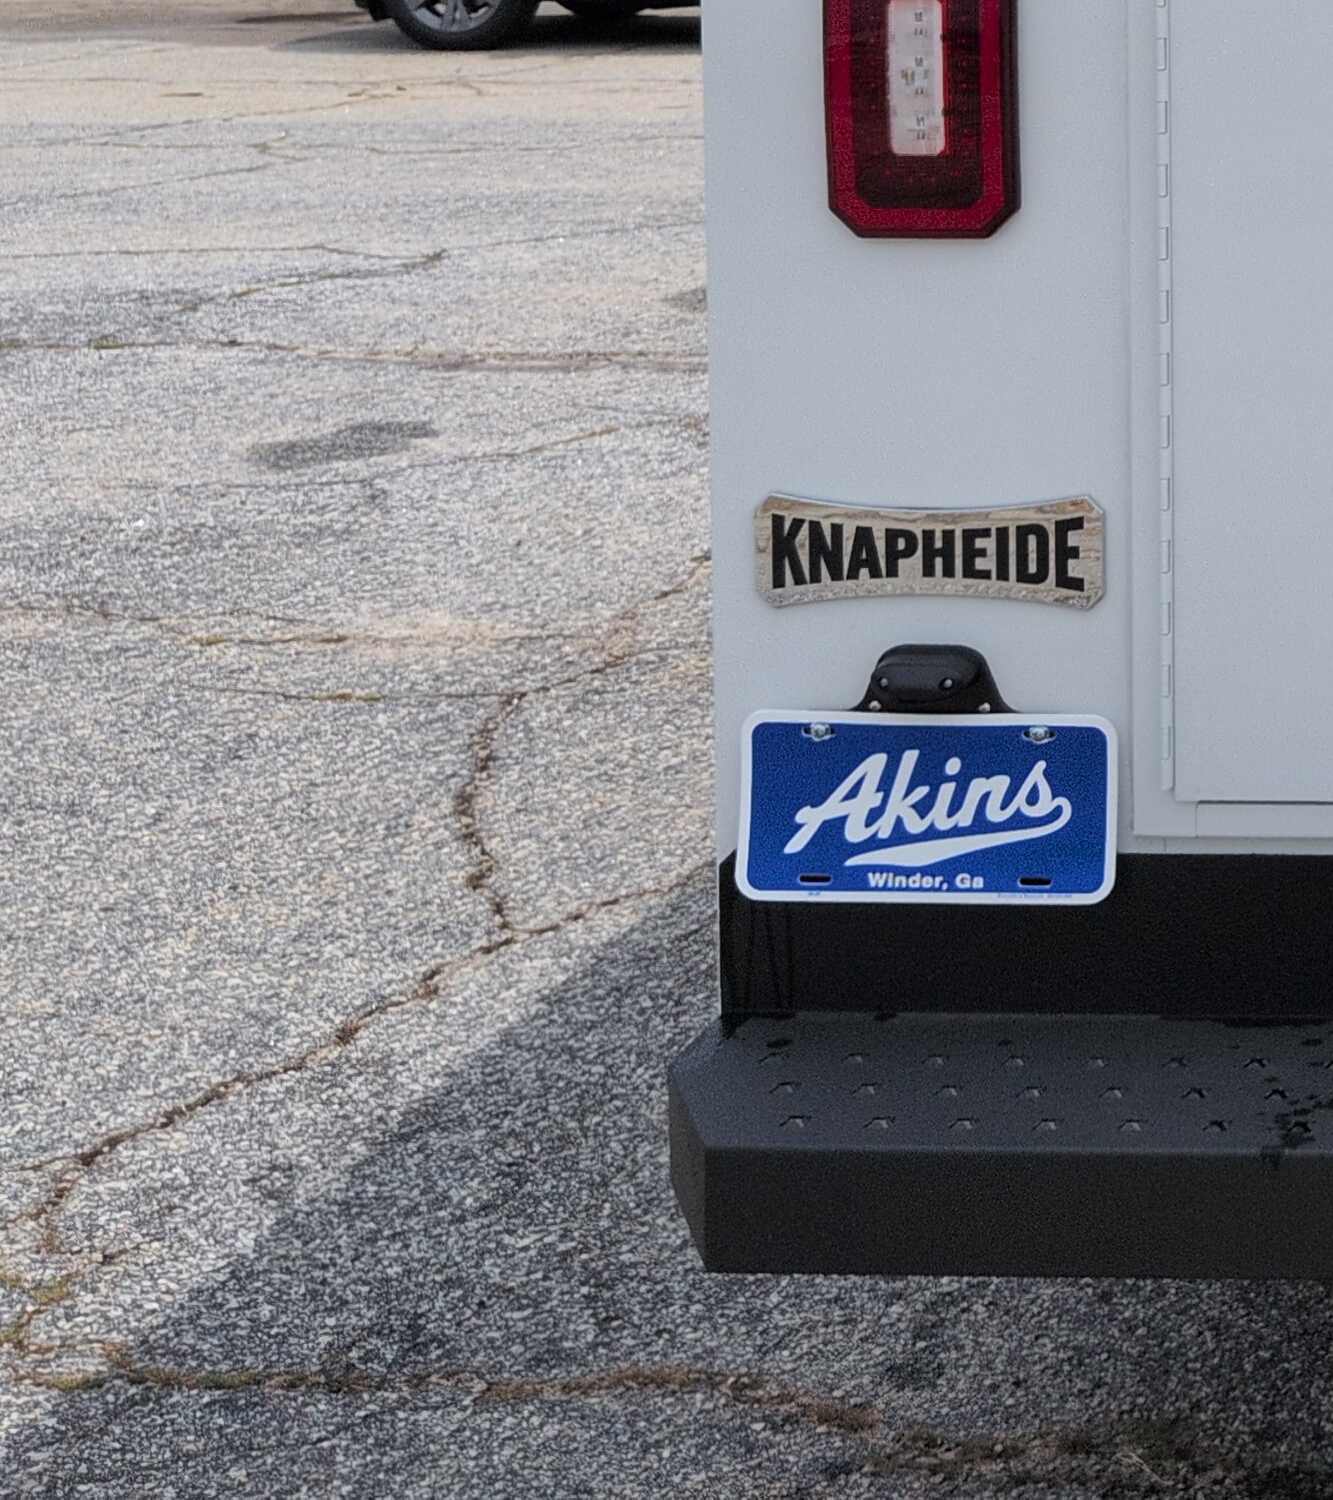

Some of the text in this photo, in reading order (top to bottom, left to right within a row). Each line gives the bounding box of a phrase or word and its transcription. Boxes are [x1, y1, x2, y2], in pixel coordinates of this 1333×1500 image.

[770, 512, 1086, 593] KNAPHEIDE
[783, 748, 1073, 860] Akins
[867, 871, 984, 891] Winder, Ga
